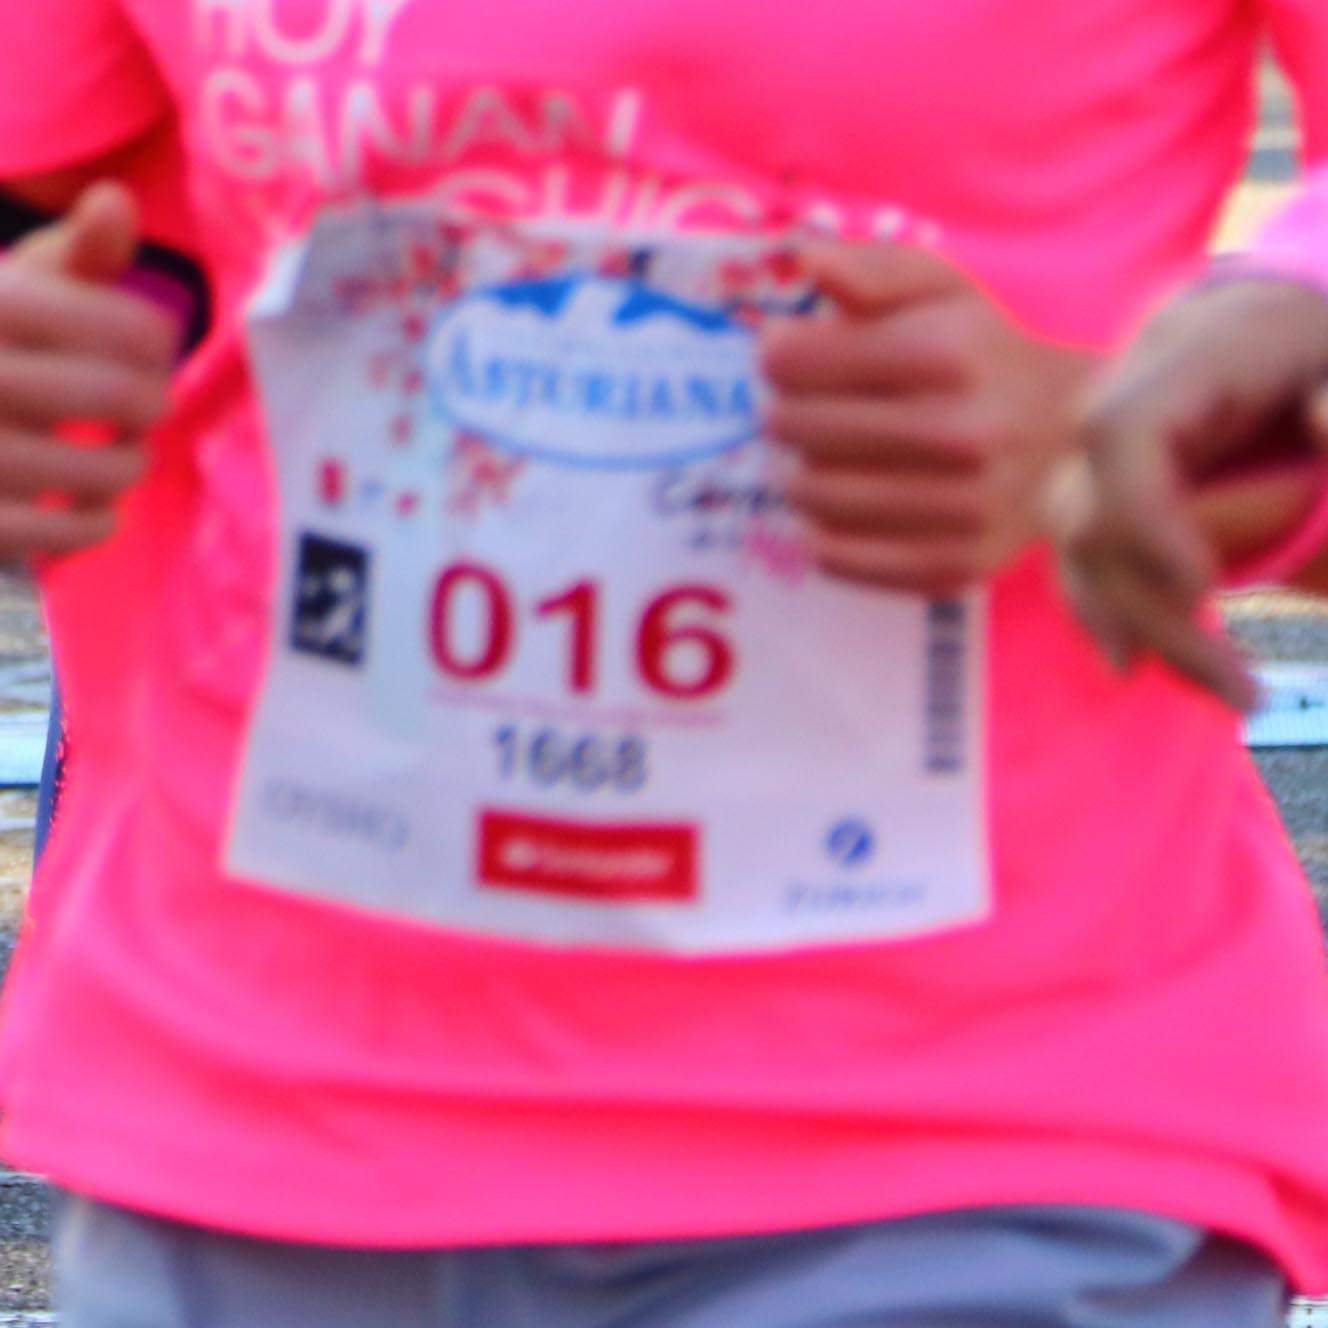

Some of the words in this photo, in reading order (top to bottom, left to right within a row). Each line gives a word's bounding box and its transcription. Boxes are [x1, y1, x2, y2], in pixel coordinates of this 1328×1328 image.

[447, 332, 756, 420] ASTURIANA
[426, 560, 736, 701] 016
[492, 722, 648, 794] 1668
